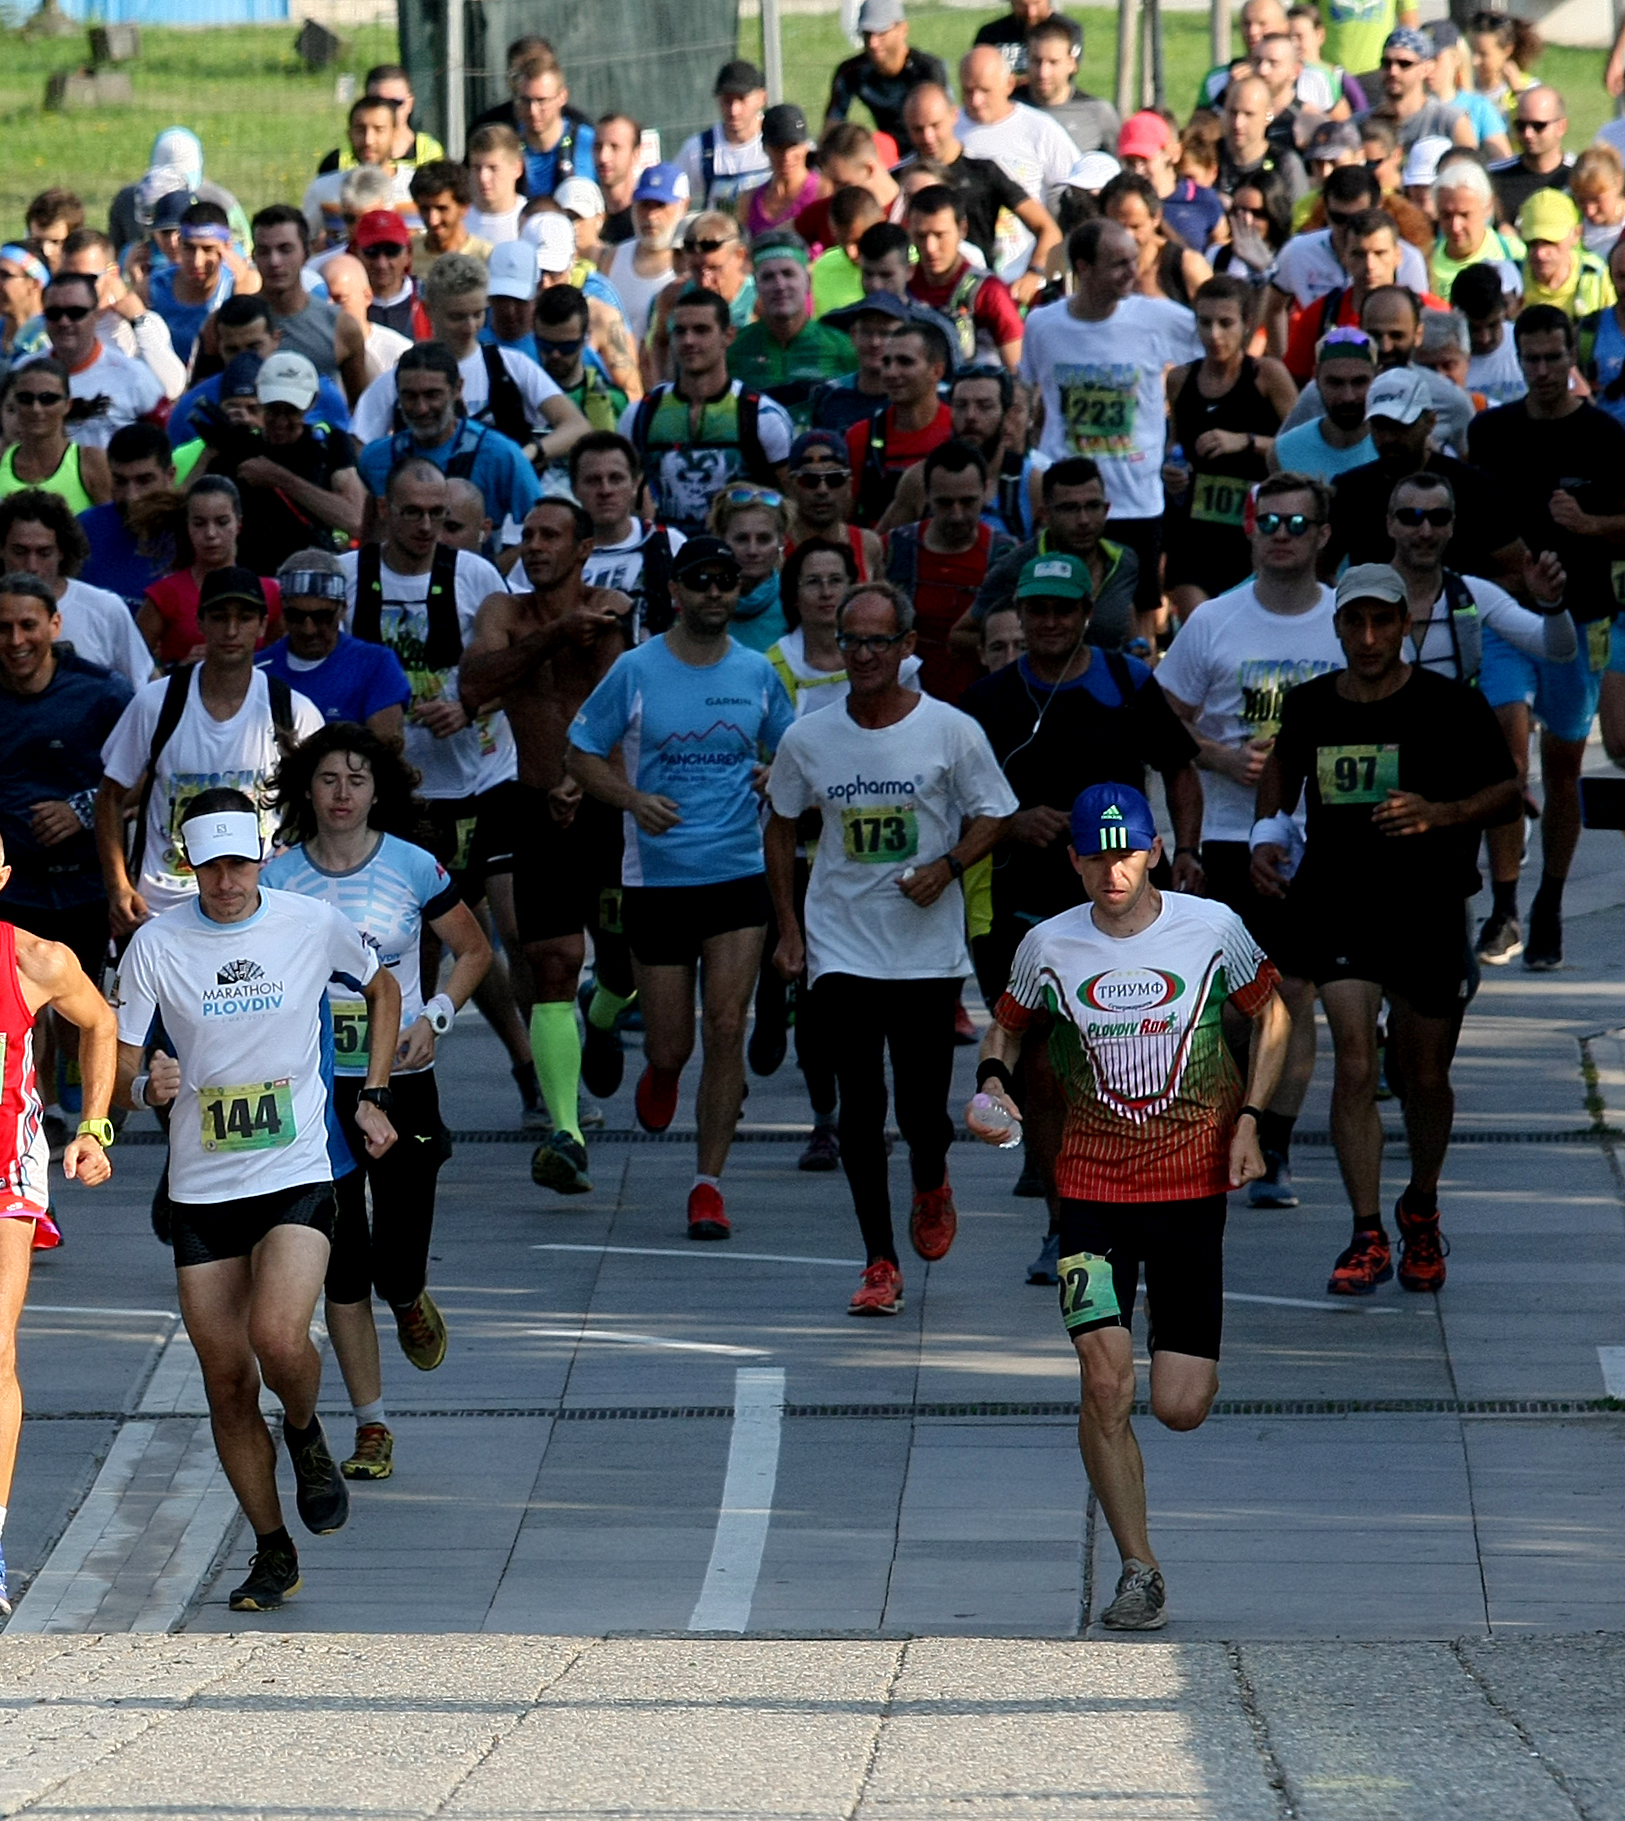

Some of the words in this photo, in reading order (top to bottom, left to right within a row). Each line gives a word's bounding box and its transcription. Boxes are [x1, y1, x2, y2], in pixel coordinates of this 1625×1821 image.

[1072, 399, 1125, 428] 223
[705, 697, 752, 707] GARMIN
[1334, 755, 1378, 792] 97
[827, 774, 916, 804] sopharma
[849, 816, 908, 853] 173
[202, 980, 285, 1001] MARATHON
[1097, 981, 1164, 999] ТРИУМФ
[202, 993, 284, 1017] PLOVDIV
[1087, 1021, 1139, 1037] PLOVDIV
[206, 1093, 283, 1140] 144
